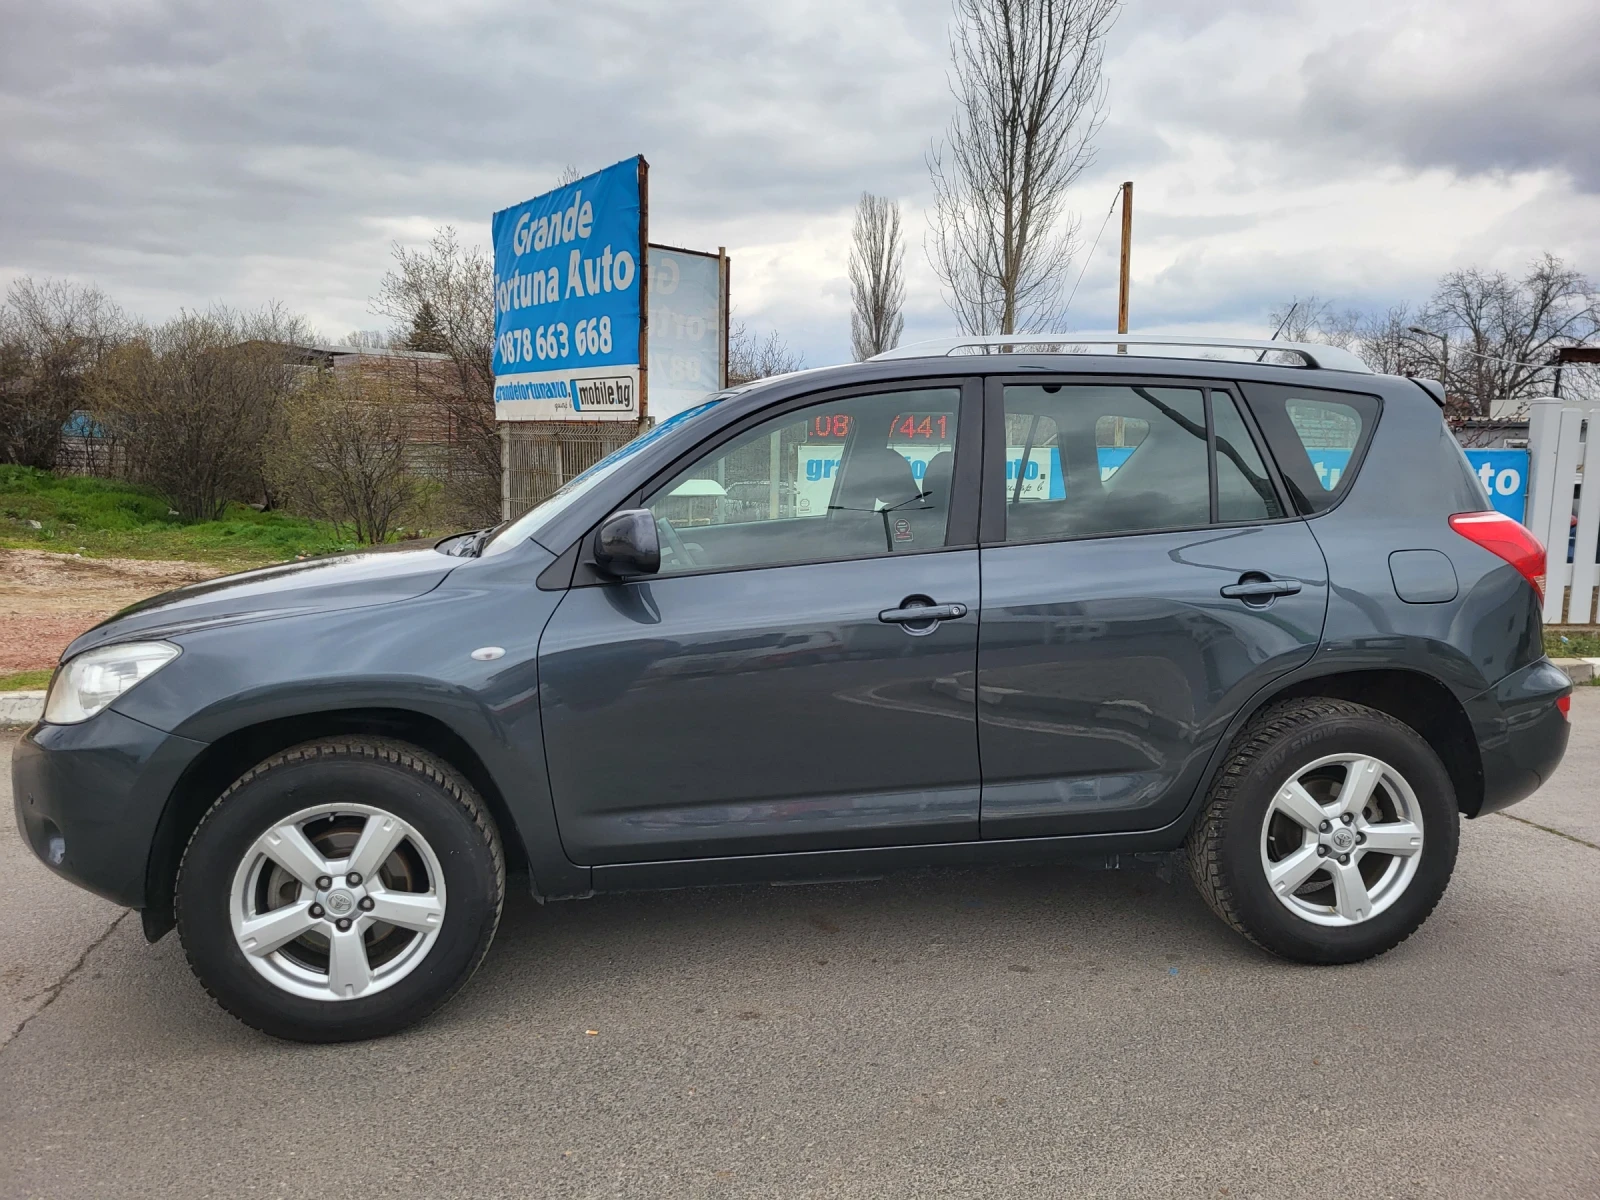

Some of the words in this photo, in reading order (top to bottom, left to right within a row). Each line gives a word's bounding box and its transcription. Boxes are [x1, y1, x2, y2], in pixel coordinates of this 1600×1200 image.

[513, 190, 594, 257] Grande
[564, 244, 636, 299] Auto
[499, 327, 533, 365] 0878
[535, 322, 570, 361] 663
[574, 315, 613, 357] 668
[578, 380, 631, 408] mobile.bg
[1291, 726, 1338, 751] SNOW
